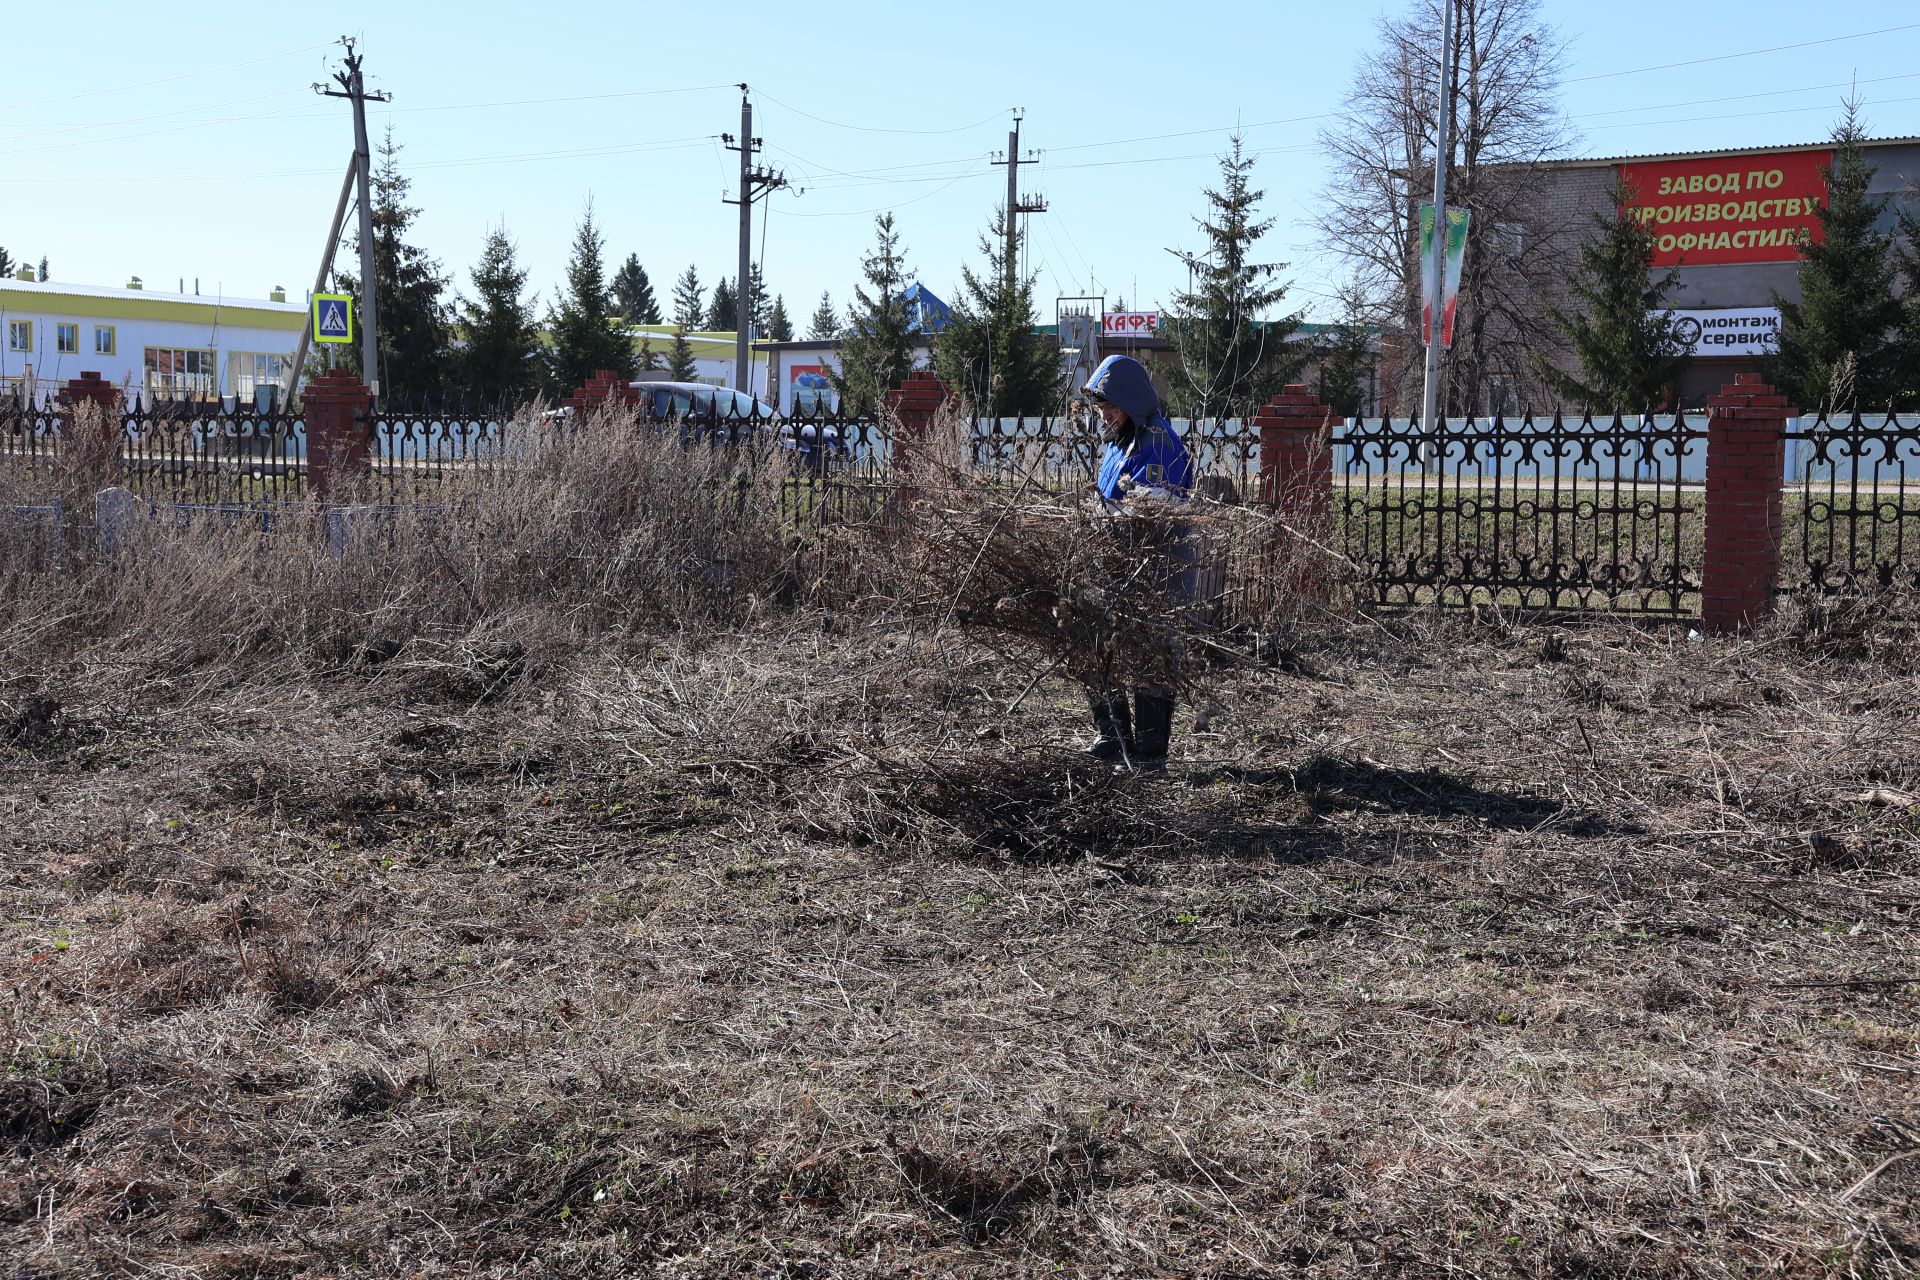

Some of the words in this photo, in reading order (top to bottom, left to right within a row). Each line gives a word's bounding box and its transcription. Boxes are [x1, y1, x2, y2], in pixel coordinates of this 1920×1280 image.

[1657, 172, 1740, 195] ЗАВОД
[1746, 169, 1784, 190] ПО
[1103, 315, 1157, 332] КАФЕ
